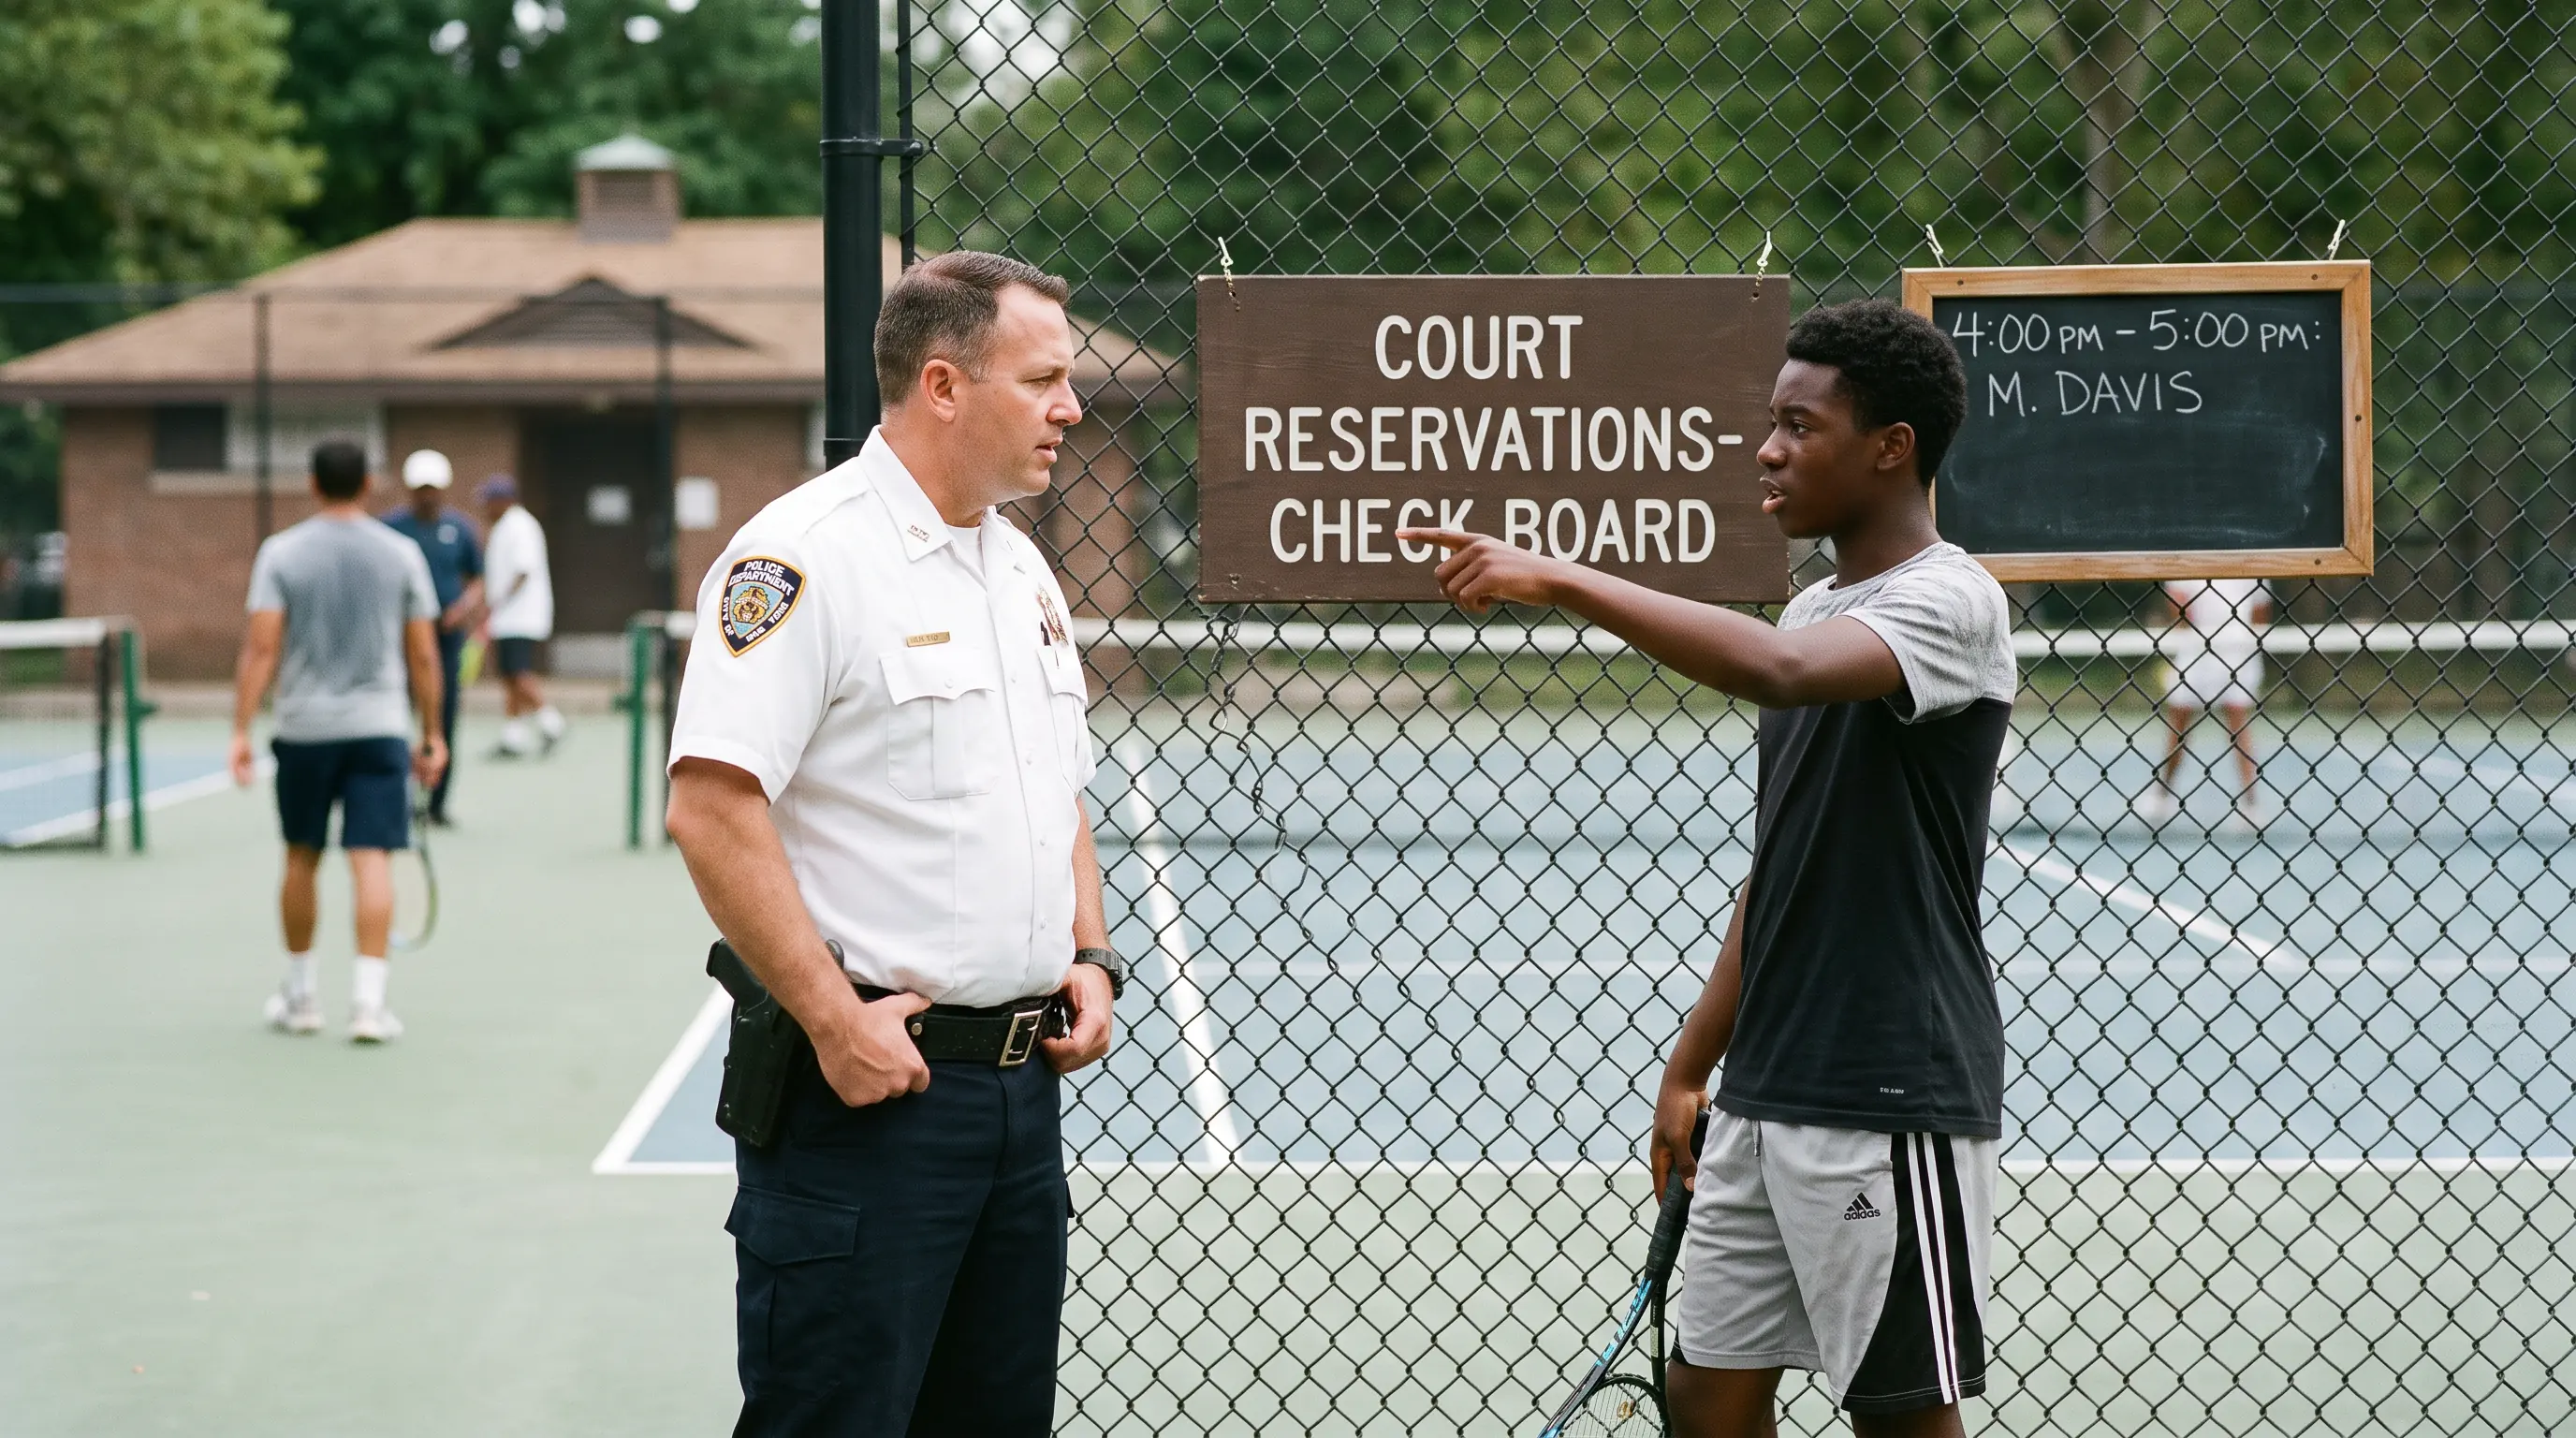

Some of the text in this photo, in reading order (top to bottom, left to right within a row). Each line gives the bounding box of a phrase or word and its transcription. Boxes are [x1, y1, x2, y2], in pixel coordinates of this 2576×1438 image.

[1375, 315, 1583, 379] COURT
[1952, 311, 2051, 357] 4:00
[2058, 323, 2104, 354] PM
[2149, 308, 2249, 351] 5:00
[2259, 320, 2321, 353] PM:
[1988, 370, 2203, 418] M. DAVIS
[1245, 406, 1743, 472] RESERVATIONS-
[1270, 498, 1717, 564] CHECK BOARD
[743, 560, 785, 578] POLICE
[1843, 1209, 1881, 1221] adidas
